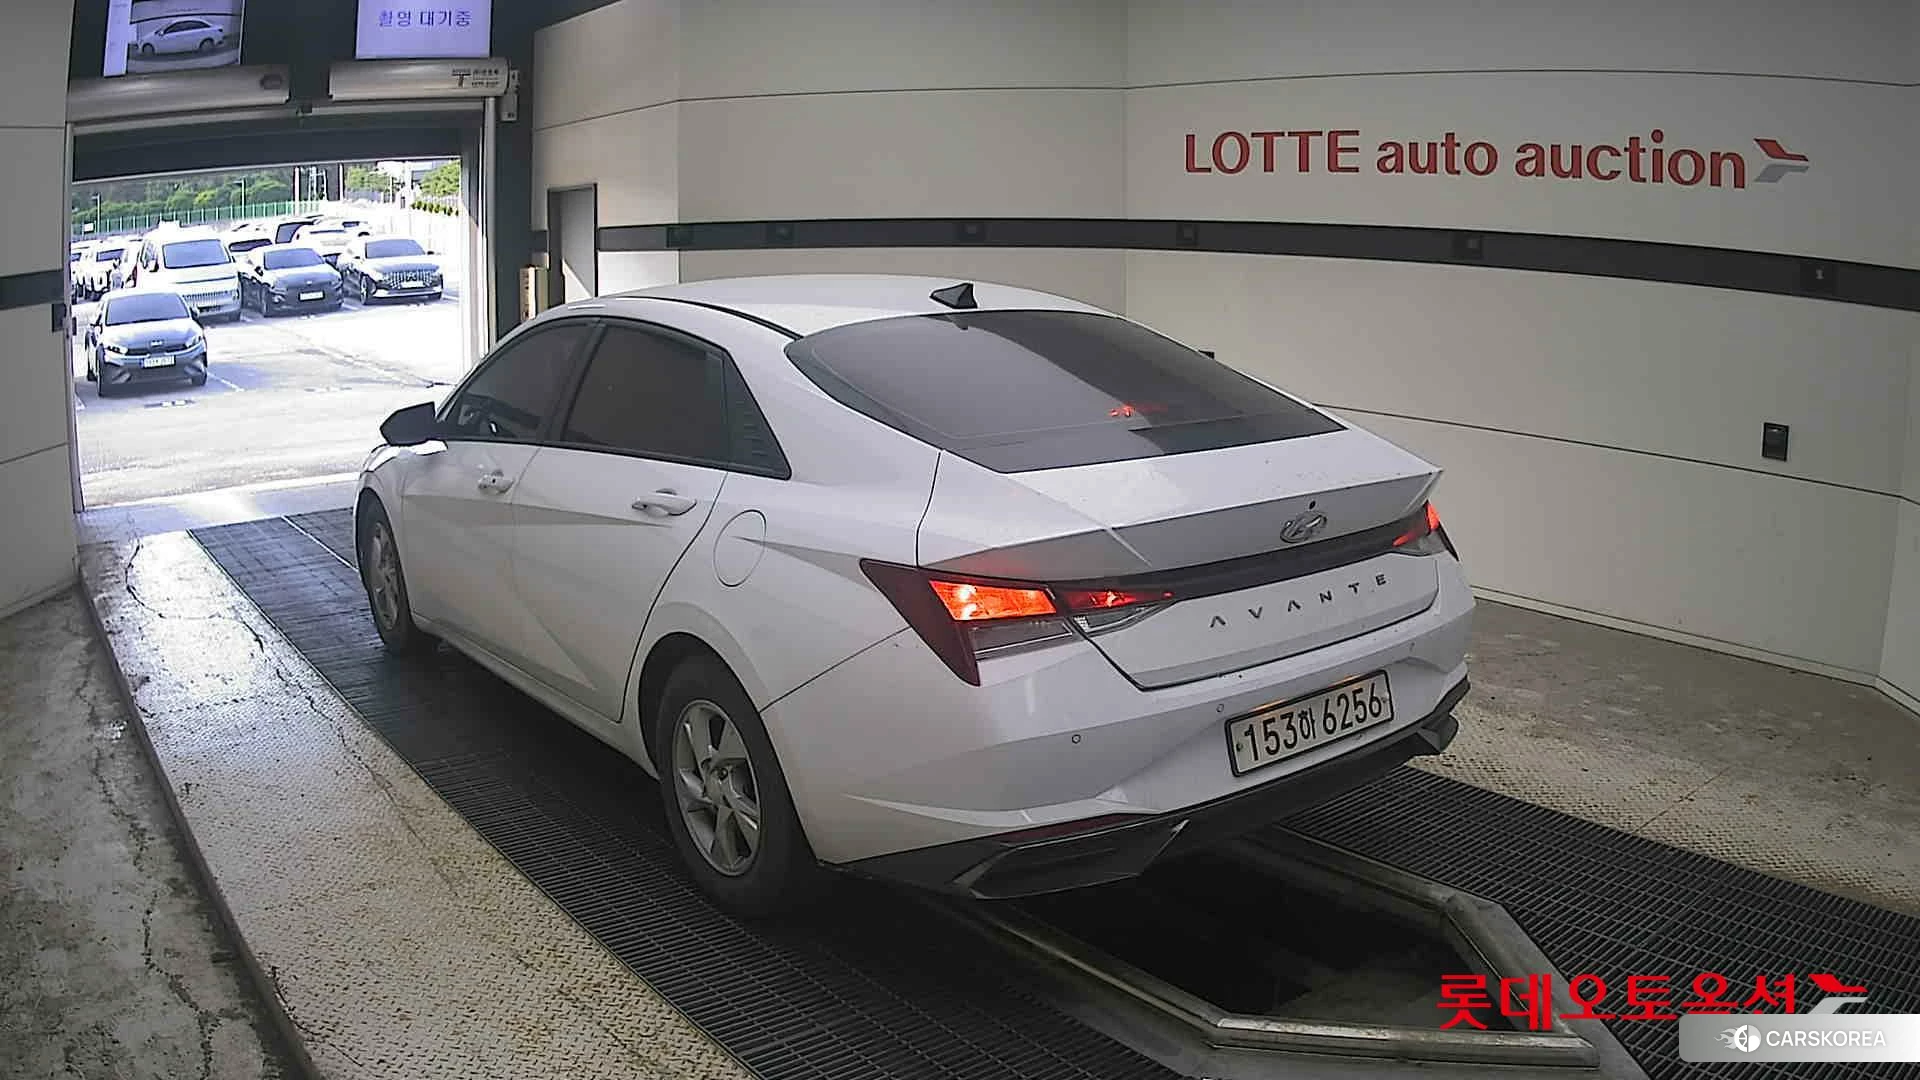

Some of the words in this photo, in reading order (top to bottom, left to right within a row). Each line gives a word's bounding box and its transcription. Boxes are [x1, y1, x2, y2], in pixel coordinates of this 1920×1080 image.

[420, 10, 471, 27] 대기중
[1185, 130, 1360, 174] LOTTE
[1376, 132, 1498, 176] auto
[1515, 129, 1745, 188] auction
[1210, 574, 1387, 628] AVANTE
[1244, 707, 1316, 761] 153하
[1322, 682, 1382, 735] 6256
